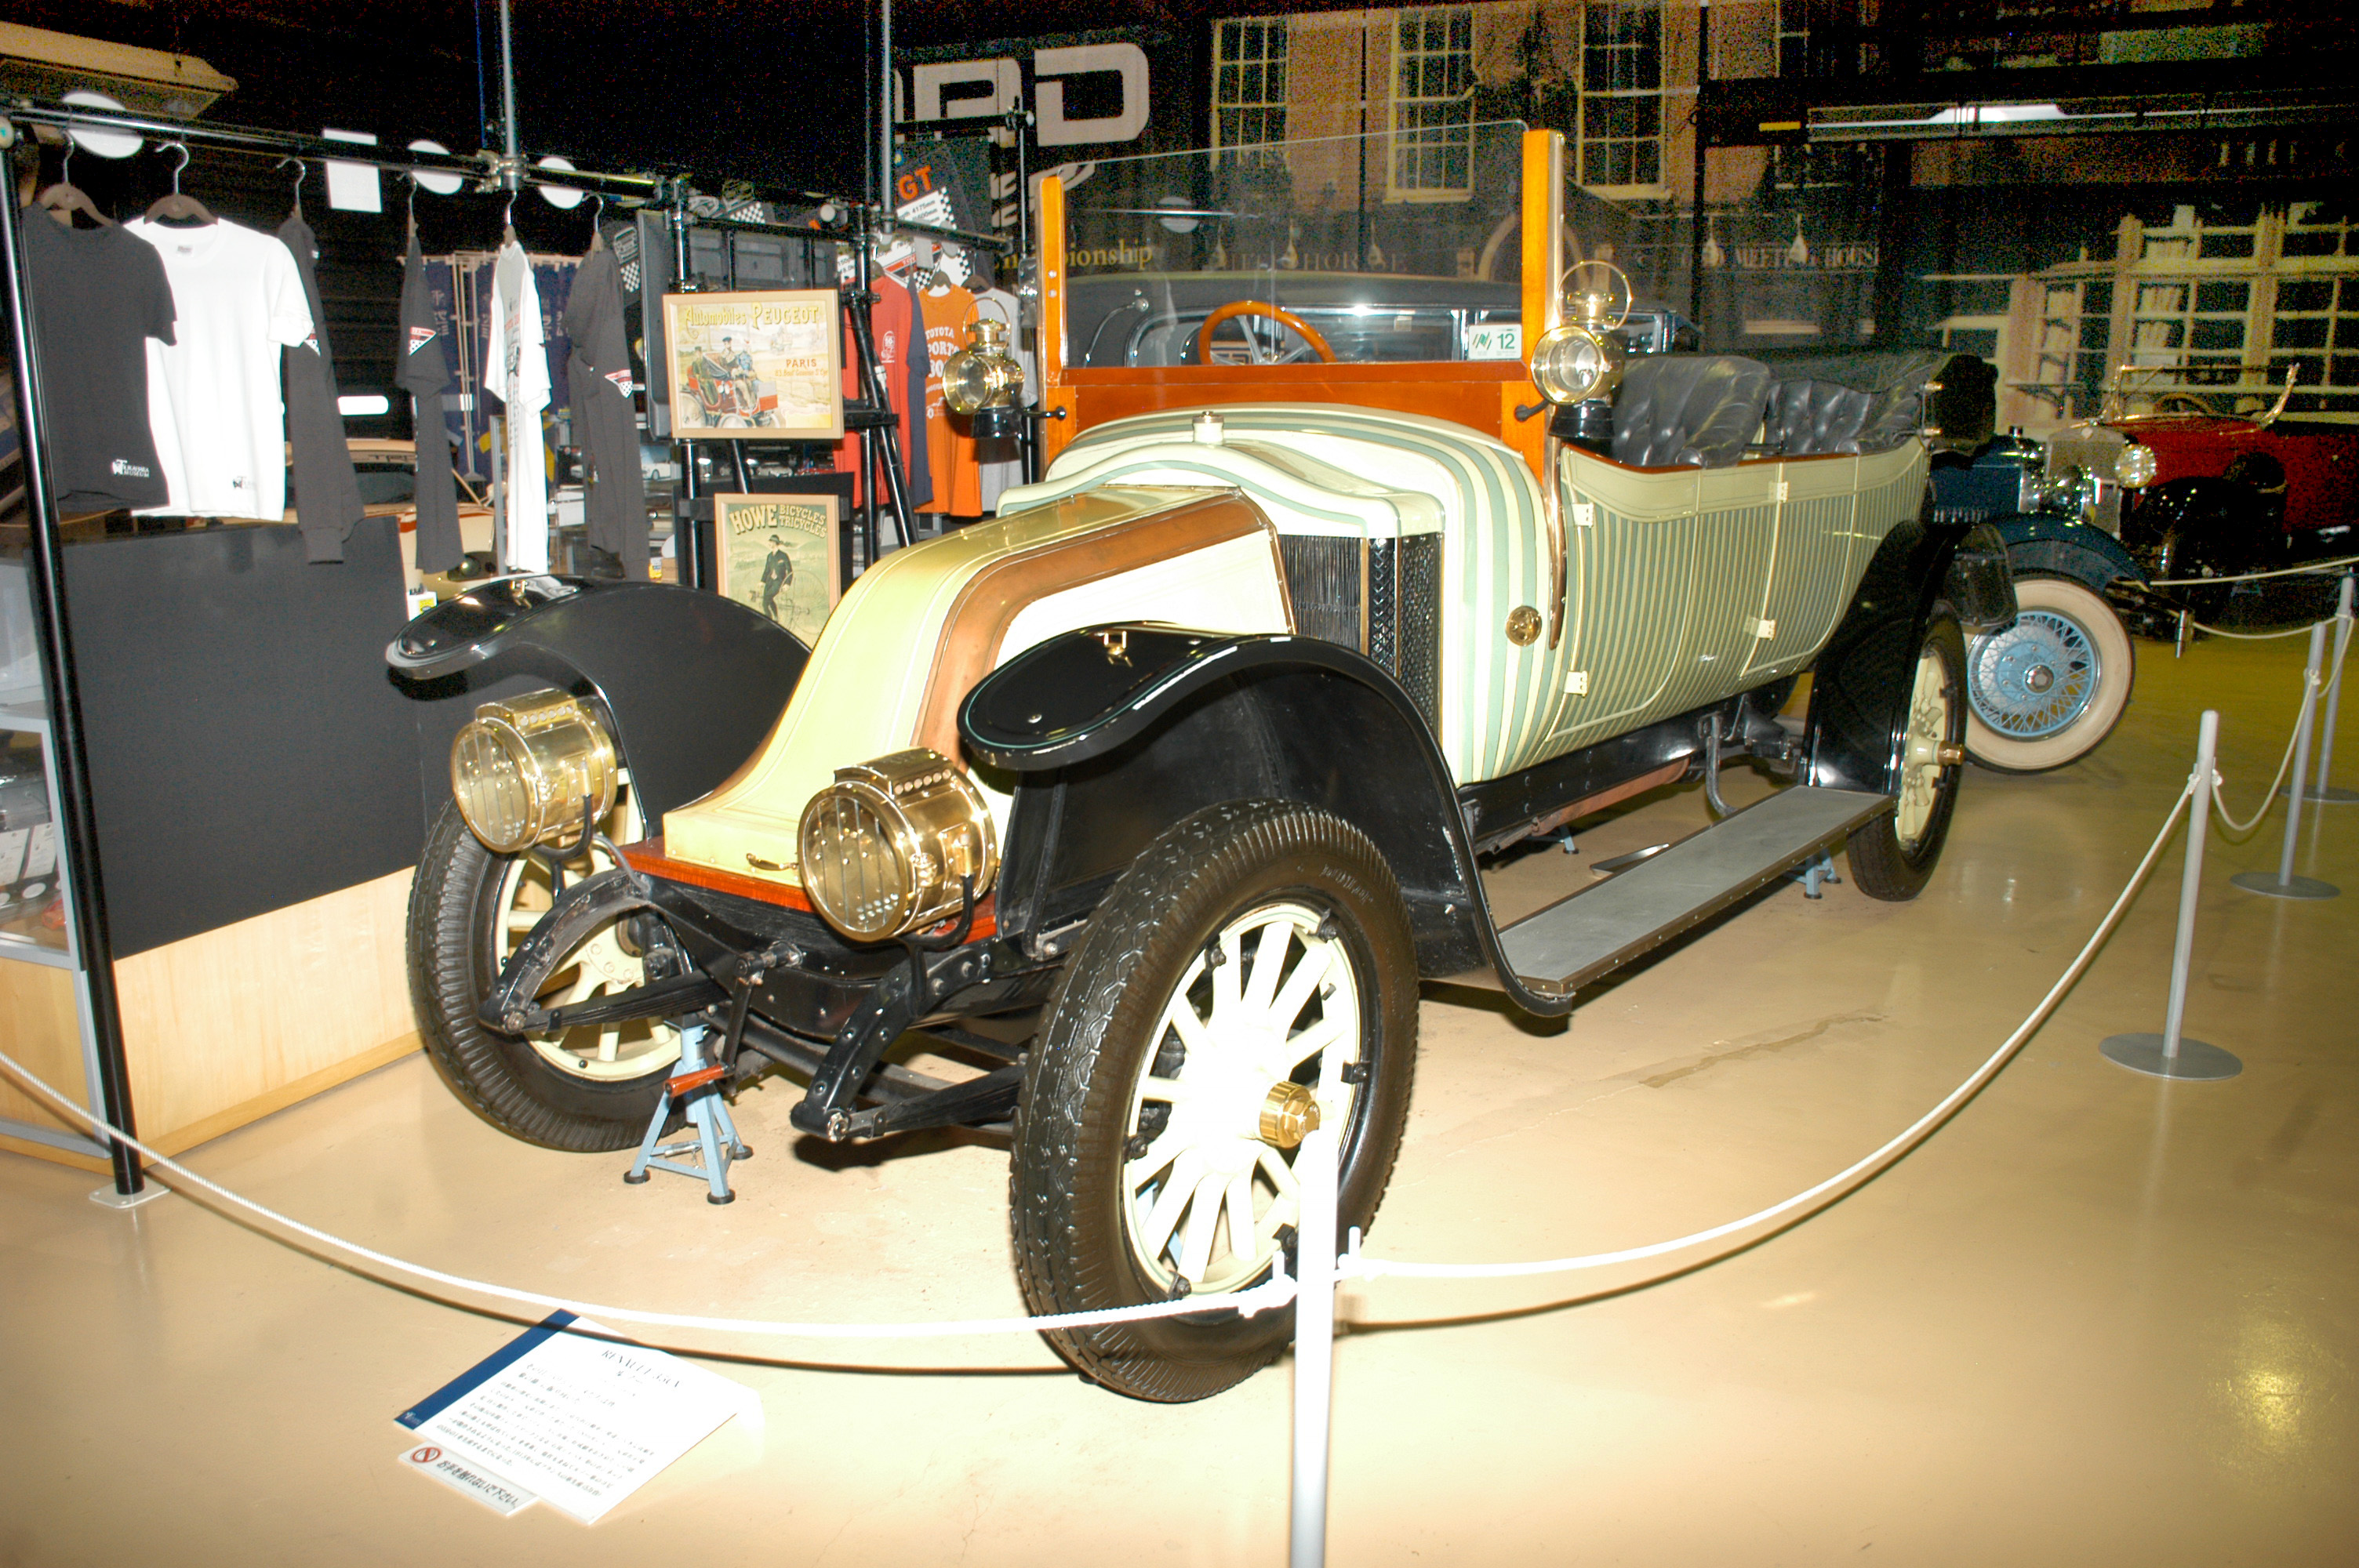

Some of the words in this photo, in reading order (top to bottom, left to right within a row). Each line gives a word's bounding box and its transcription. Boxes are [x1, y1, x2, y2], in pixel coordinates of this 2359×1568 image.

[751, 302, 819, 330] PEUGEOT
[925, 326, 954, 340] TOYOTA
[1497, 333, 1515, 350] 12
[786, 358, 817, 369] PARIS
[729, 504, 777, 534] HOWE
[780, 505, 826, 524] BICYCLES
[779, 515, 827, 538] TRICYCLES
